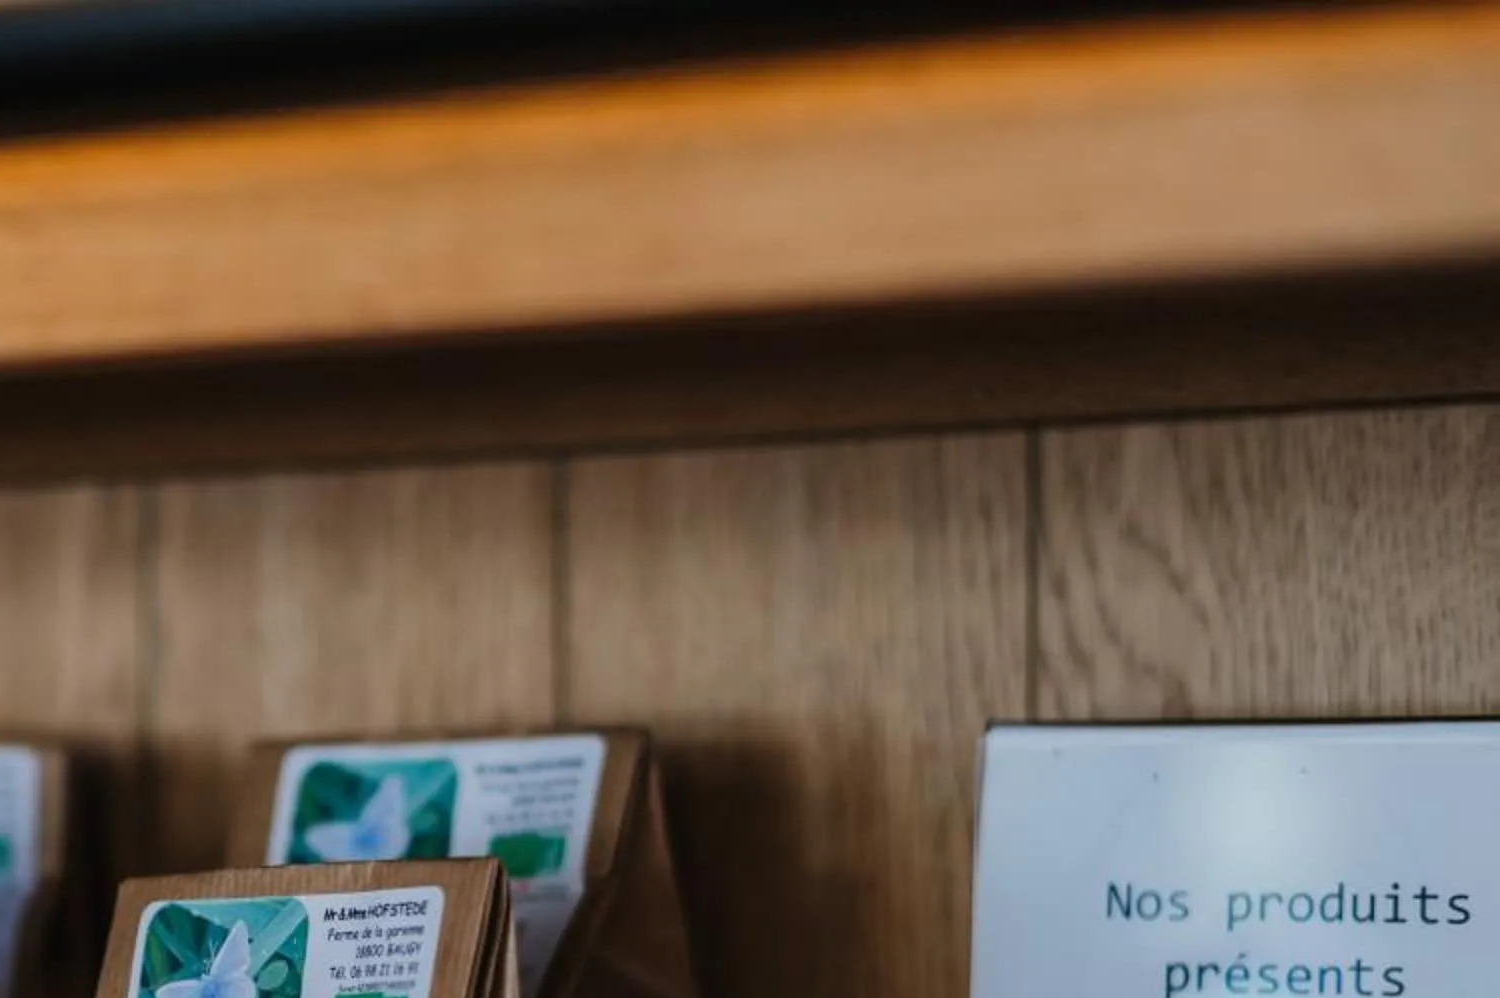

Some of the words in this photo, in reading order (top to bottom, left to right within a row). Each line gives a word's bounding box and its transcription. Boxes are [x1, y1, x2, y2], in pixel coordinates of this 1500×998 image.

[368, 900, 428, 918] HOFSTEDE
[1105, 882, 1191, 923] Nos
[1226, 882, 1472, 932] produits
